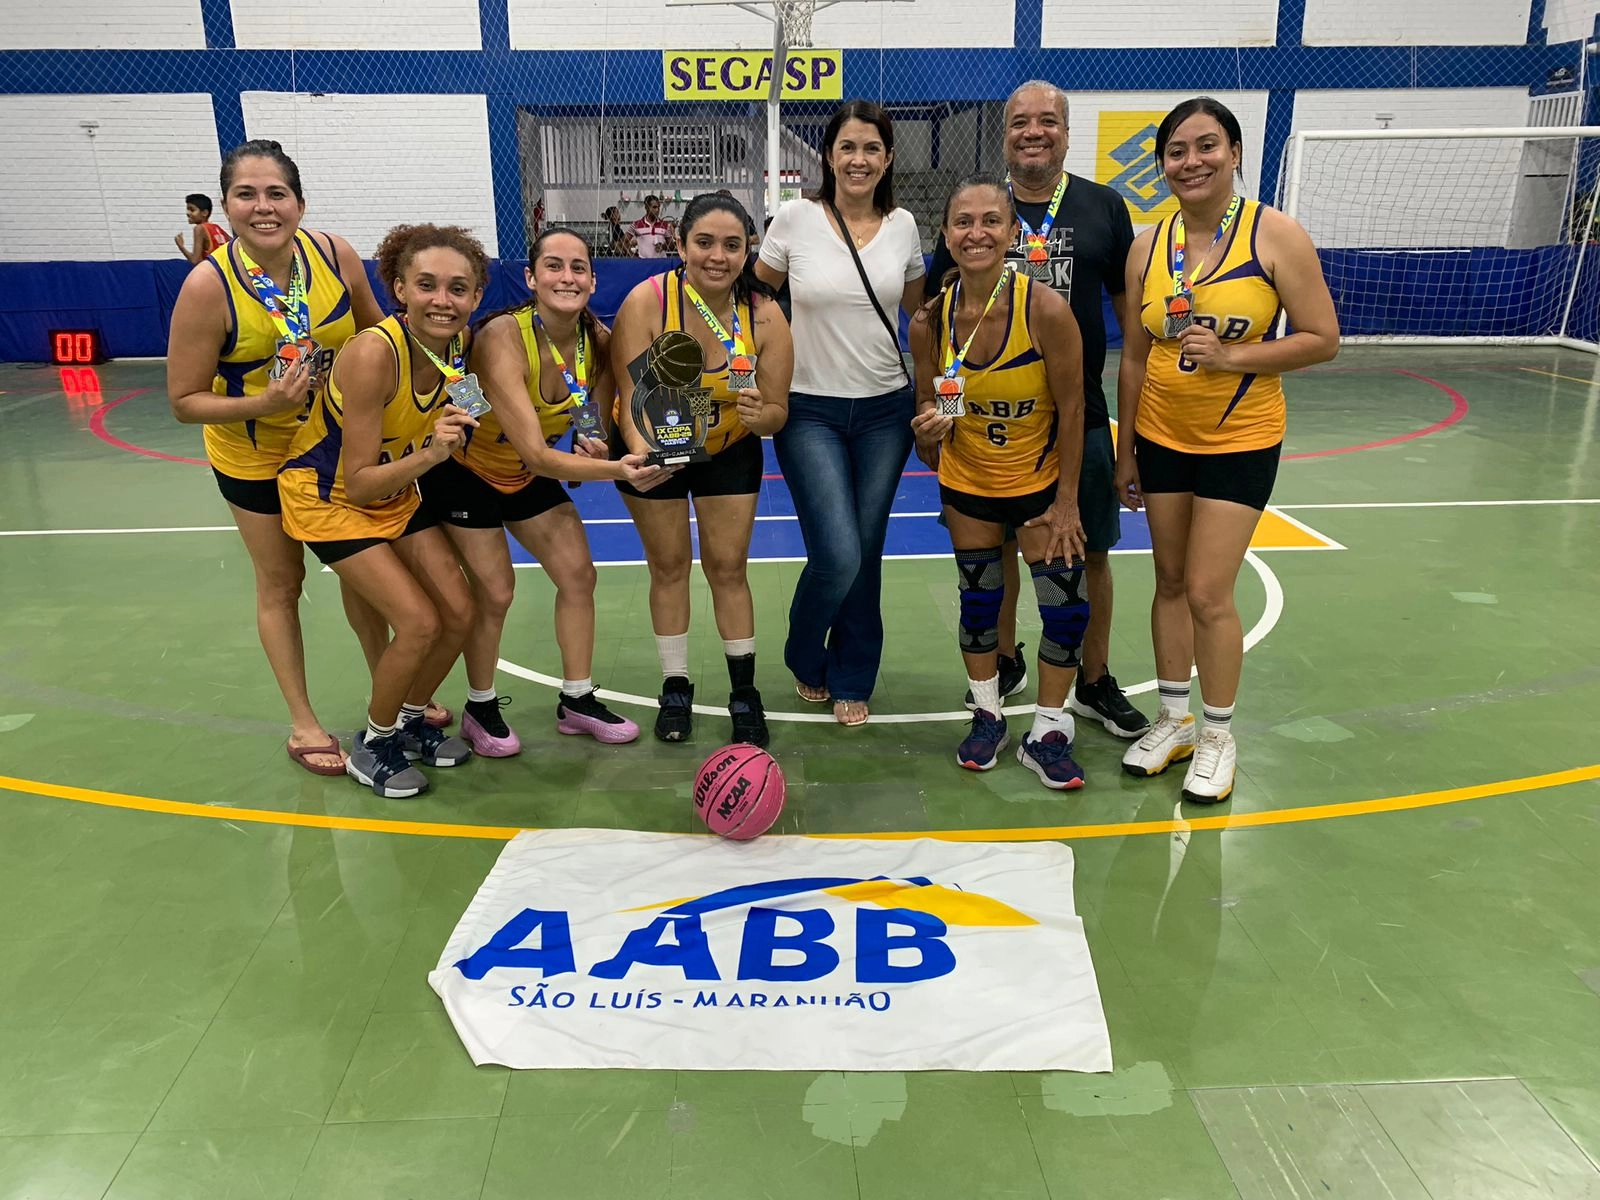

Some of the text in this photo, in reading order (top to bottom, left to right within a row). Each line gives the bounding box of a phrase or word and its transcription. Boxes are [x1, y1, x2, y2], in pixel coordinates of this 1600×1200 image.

[670, 56, 837, 91] SEGASP
[57, 334, 91, 361] 00
[986, 422, 1008, 447] 6
[695, 754, 738, 808] Wilson
[716, 776, 752, 820] NCAA
[453, 907, 957, 983] AABB
[507, 982, 576, 1009] SÃO
[589, 988, 663, 1009] LUÍS
